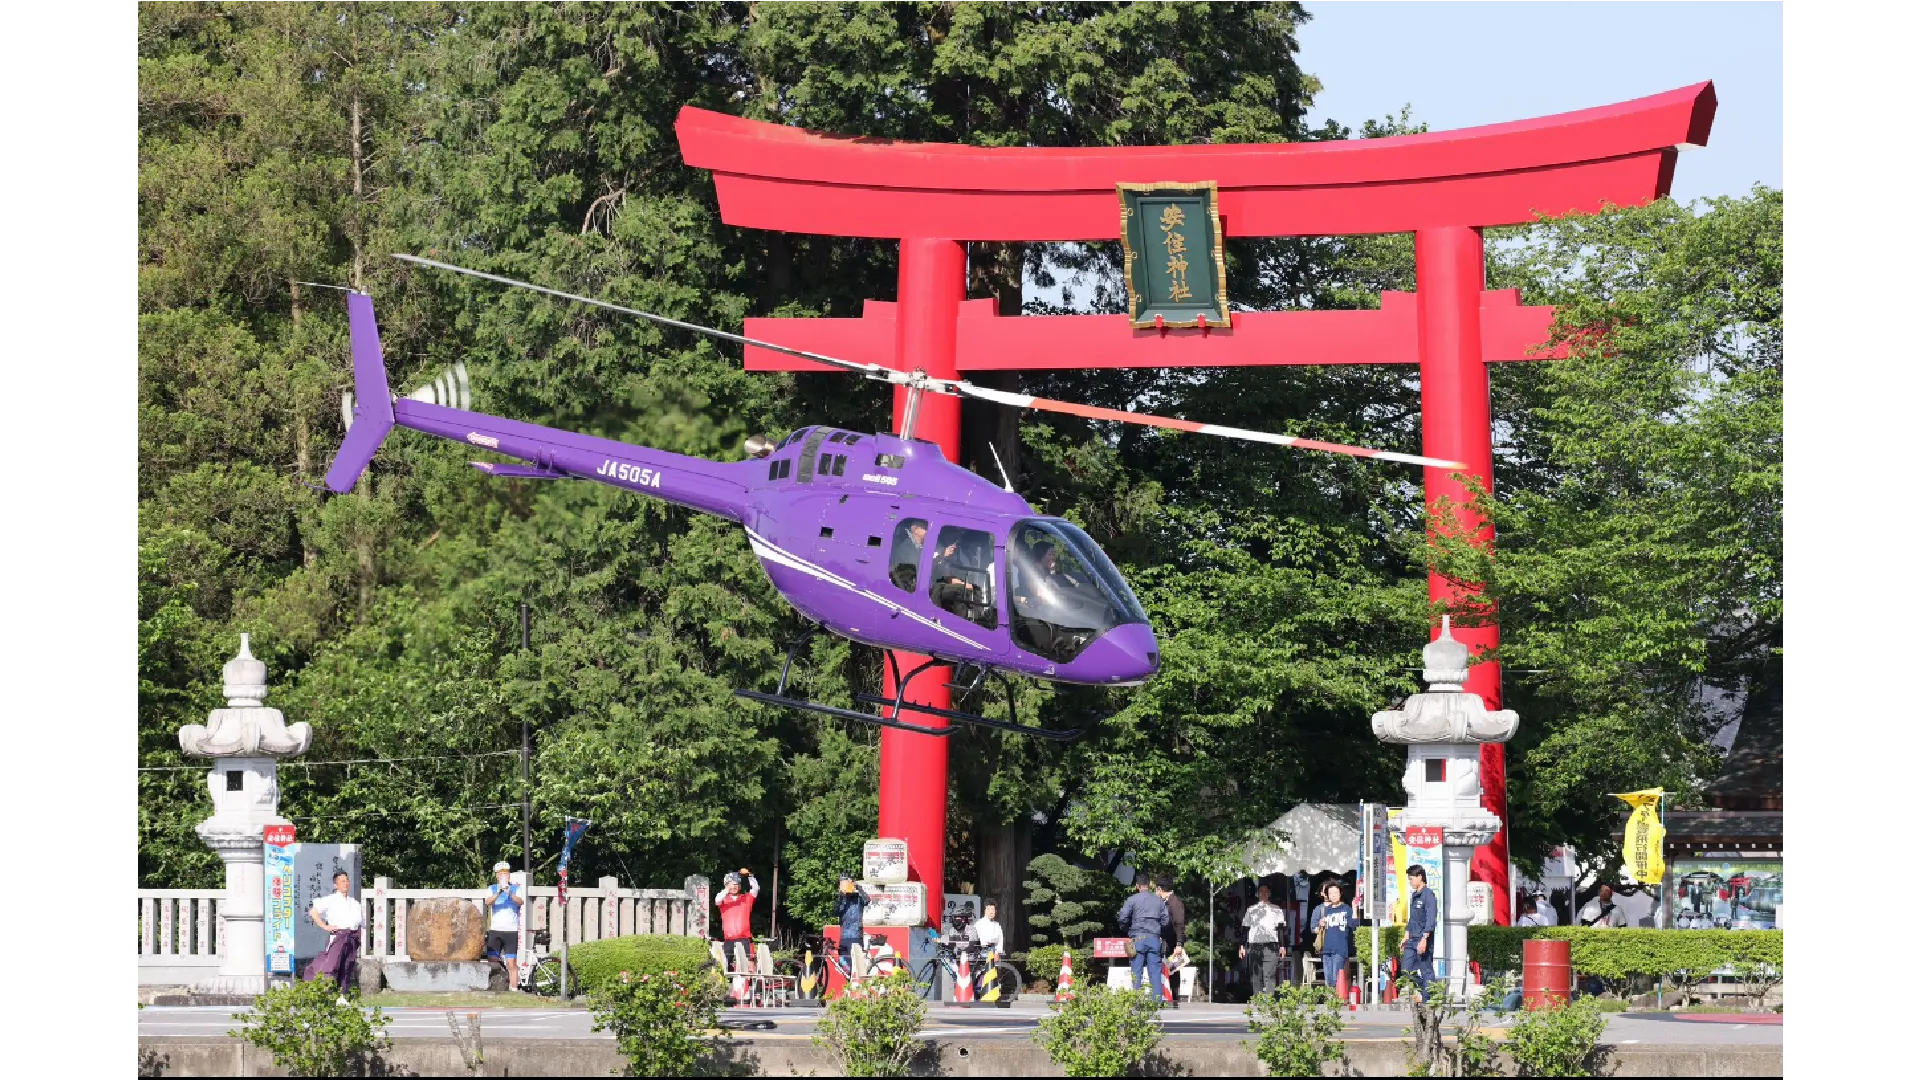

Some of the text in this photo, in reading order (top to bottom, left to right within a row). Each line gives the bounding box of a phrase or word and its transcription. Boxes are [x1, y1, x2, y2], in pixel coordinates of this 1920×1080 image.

[1160, 203, 1192, 302] 安住神社
[597, 460, 660, 487] JA505A
